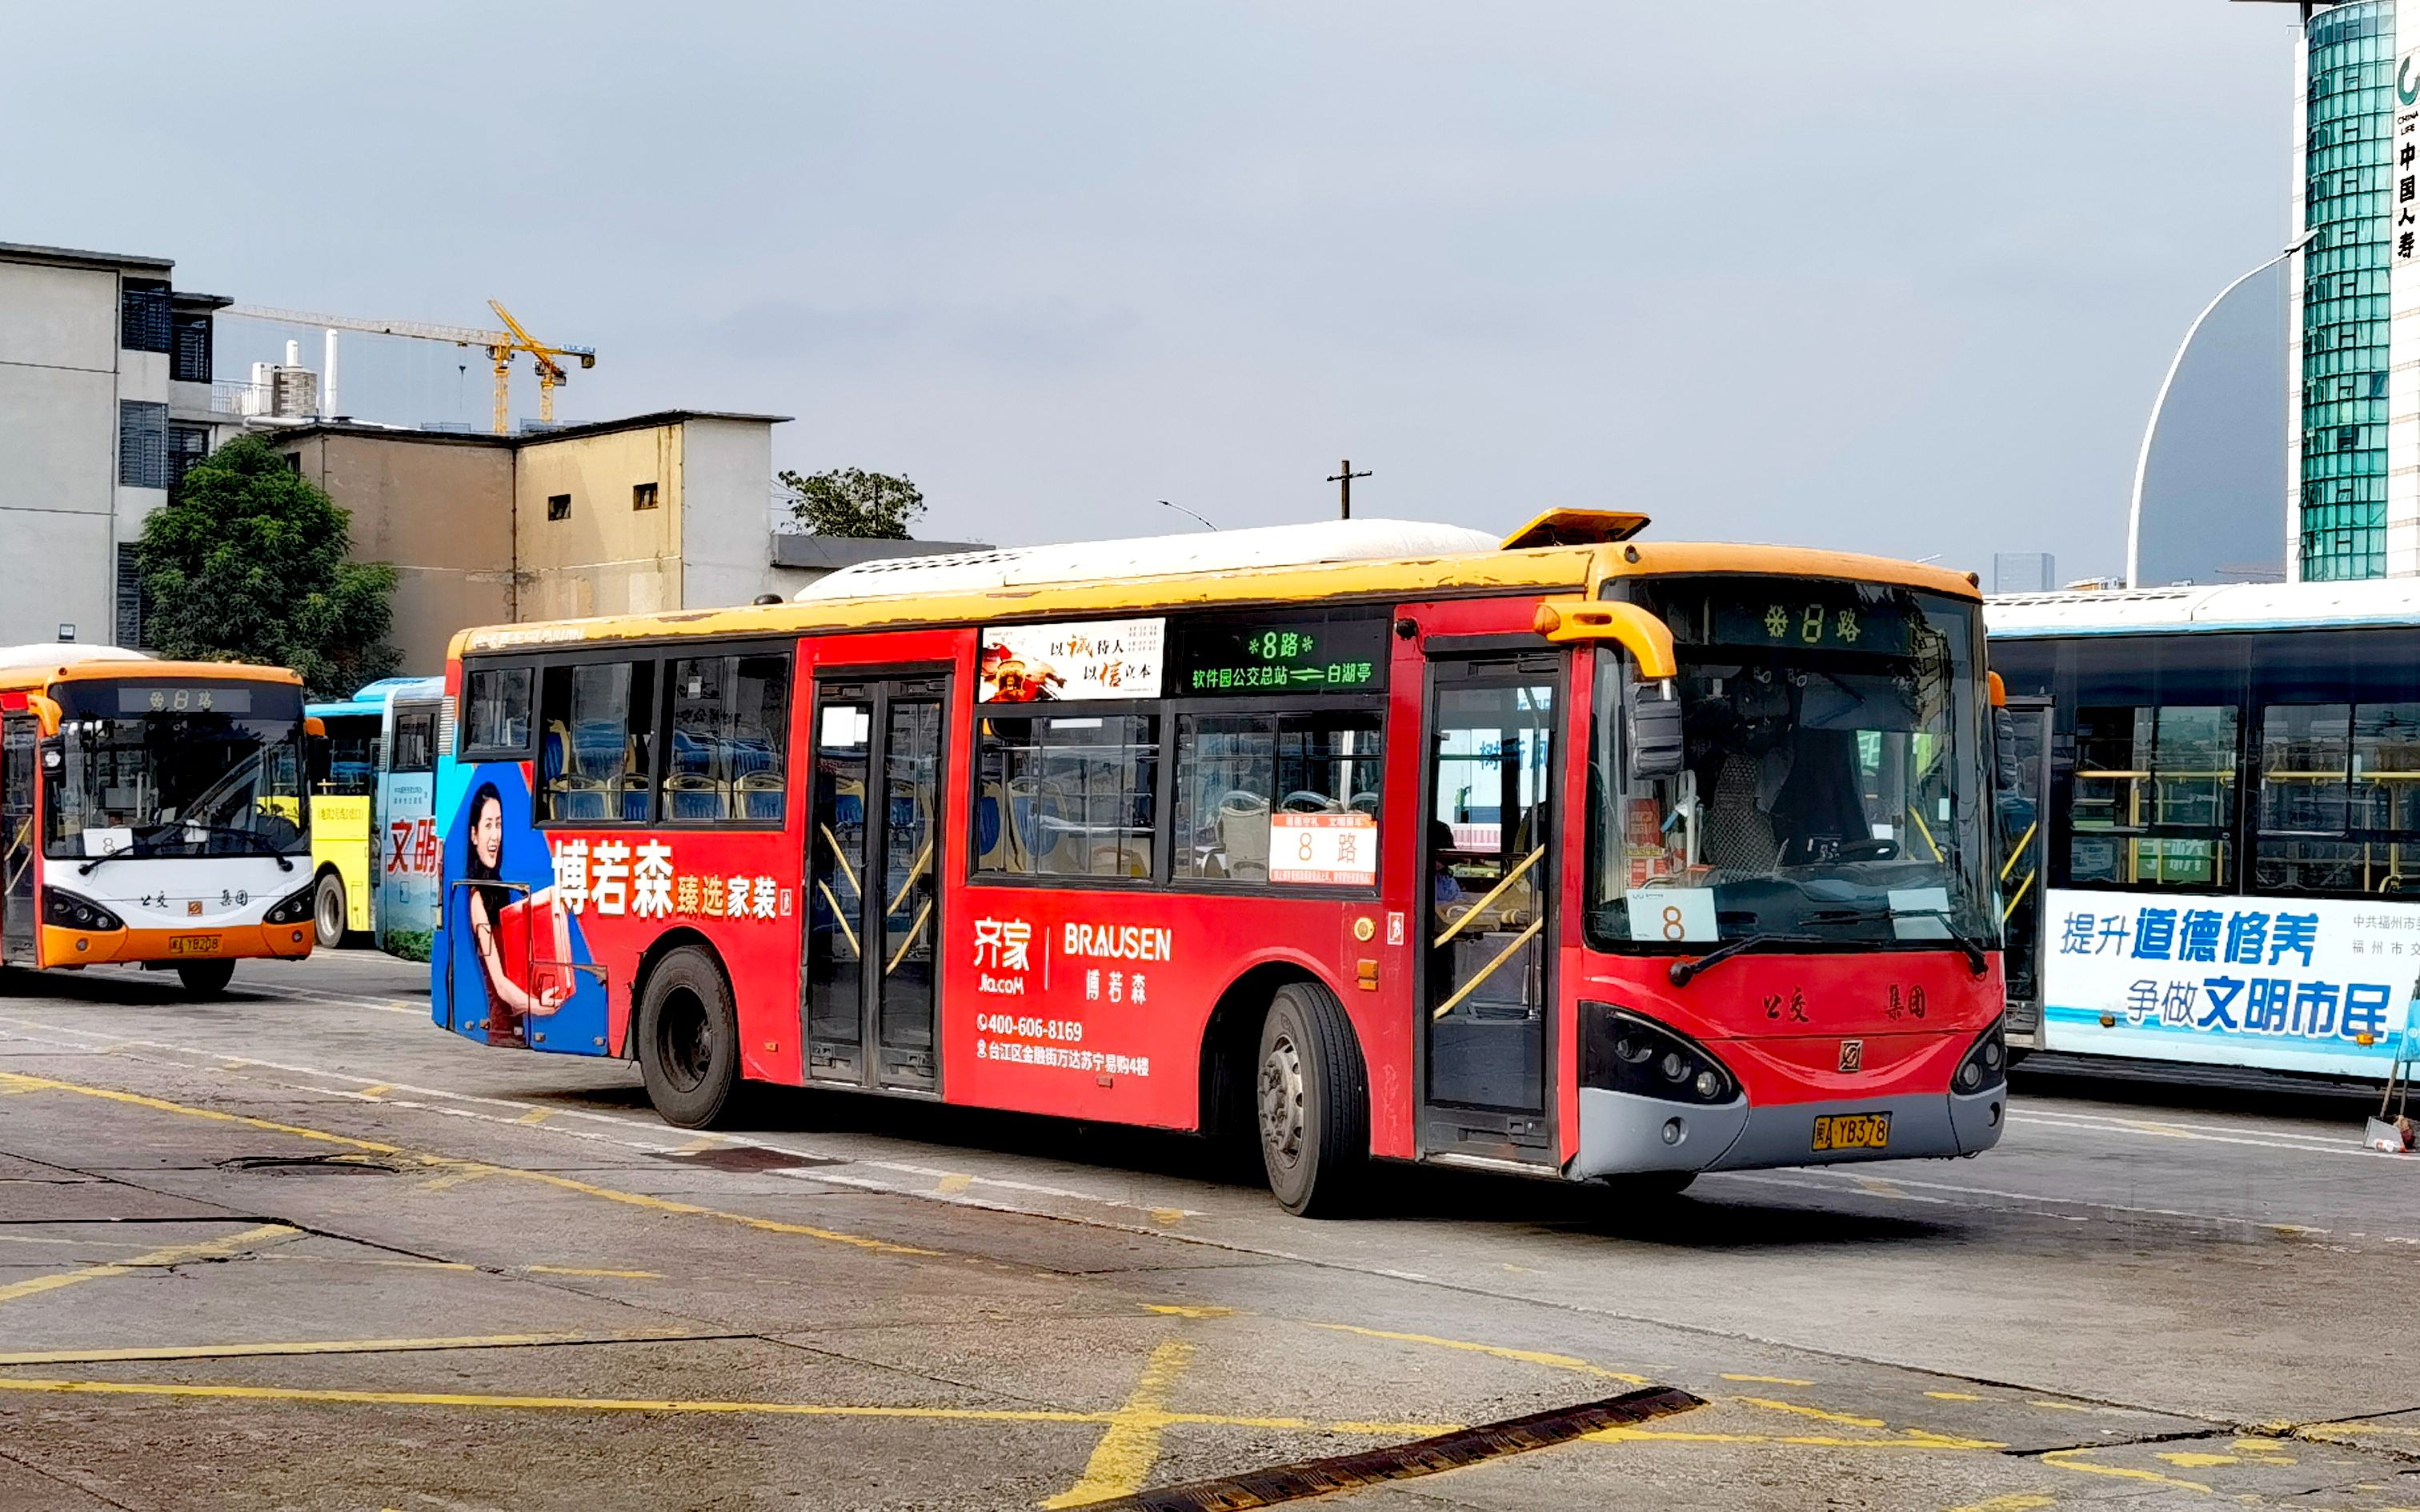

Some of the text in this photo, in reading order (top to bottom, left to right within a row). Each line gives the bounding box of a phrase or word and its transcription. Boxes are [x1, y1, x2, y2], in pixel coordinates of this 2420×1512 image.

[2398, 142, 2415, 259] 中国人寿
[1192, 662, 1372, 689] 软件园公交总站 白湖亭
[102, 837, 115, 854] 8
[387, 818, 443, 874] 文明
[551, 838, 777, 919] 博若森 臻选家装
[973, 916, 1032, 971] 齐家
[1064, 922, 1172, 962] BRAUSEN
[1663, 906, 1685, 942] 8
[2059, 906, 2319, 967] 提升道德修养
[1085, 969, 1147, 1005] 博若森
[1763, 983, 1926, 1023] 公交 集团
[2126, 974, 2391, 1038] 争做文明市民
[988, 1014, 1083, 1042] 400-606-8169
[989, 1041, 1149, 1077] 台江区金融街万达苏宁易购4楼
